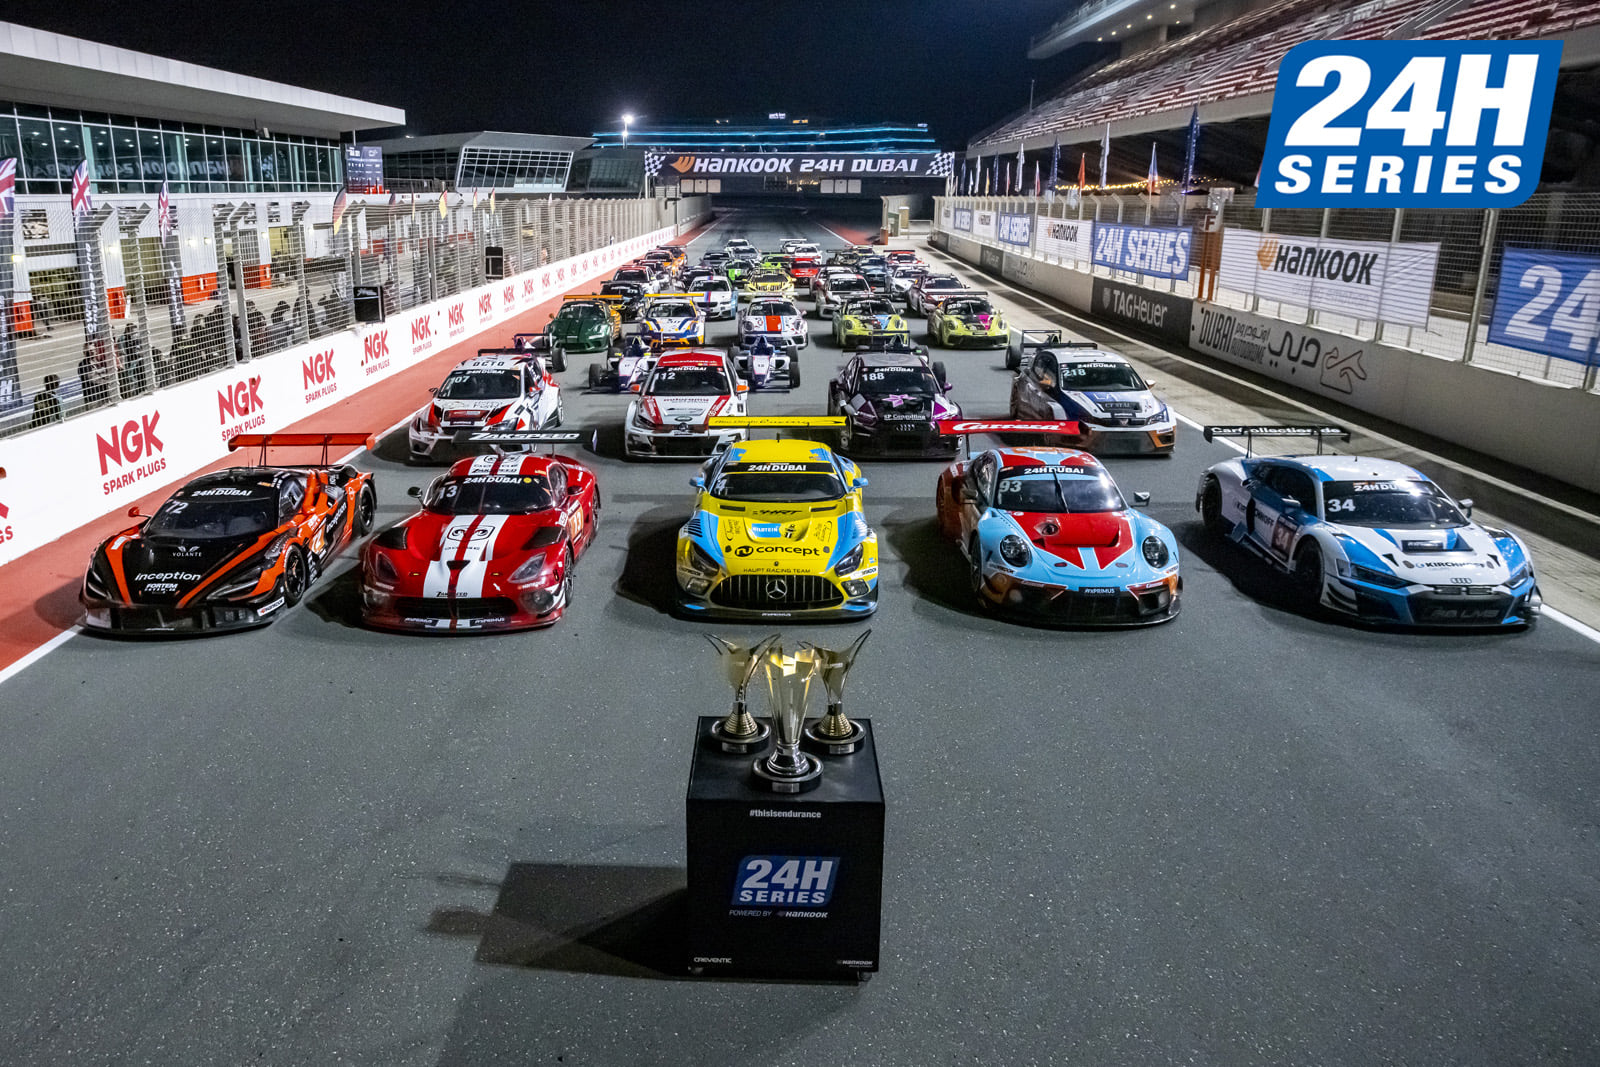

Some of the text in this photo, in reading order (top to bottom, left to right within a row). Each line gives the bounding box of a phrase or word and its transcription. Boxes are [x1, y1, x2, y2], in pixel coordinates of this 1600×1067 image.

[800, 158, 845, 173] 24H
[852, 158, 918, 173] DUBAI
[1095, 227, 1189, 275] 24H SERIES
[523, 278, 534, 295] NGK
[503, 286, 515, 306] NGK
[479, 292, 492, 317] NGK
[449, 302, 464, 329] NGK
[411, 314, 431, 344] NGK
[1198, 310, 1237, 353] DUBAI
[365, 329, 389, 364] NGK
[1268, 330, 1322, 375] دبي
[302, 349, 335, 390] NGK
[655, 372, 676, 380] 112
[862, 373, 885, 382] 188
[217, 374, 264, 426] NGK
[305, 382, 337, 404] SPARK PLUGS
[221, 414, 266, 442] SPARK PLUGS
[952, 421, 1061, 431] Carrera
[96, 410, 164, 476] NGK
[469, 432, 580, 441] ZAKSPEED
[103, 458, 167, 495] SPARK PLUGS
[487, 476, 522, 484] DUBAI
[440, 485, 458, 500] 13
[1000, 481, 1022, 493] 93
[1354, 484, 1379, 492] 24H
[165, 500, 188, 514] 72
[1328, 499, 1356, 512] 34
[756, 546, 820, 556] concept
[135, 571, 201, 582] inception
[749, 809, 822, 818] #thisisendurance
[742, 860, 832, 890] 24H
[739, 891, 825, 904] SERIES
[729, 909, 762, 917] POWERED
